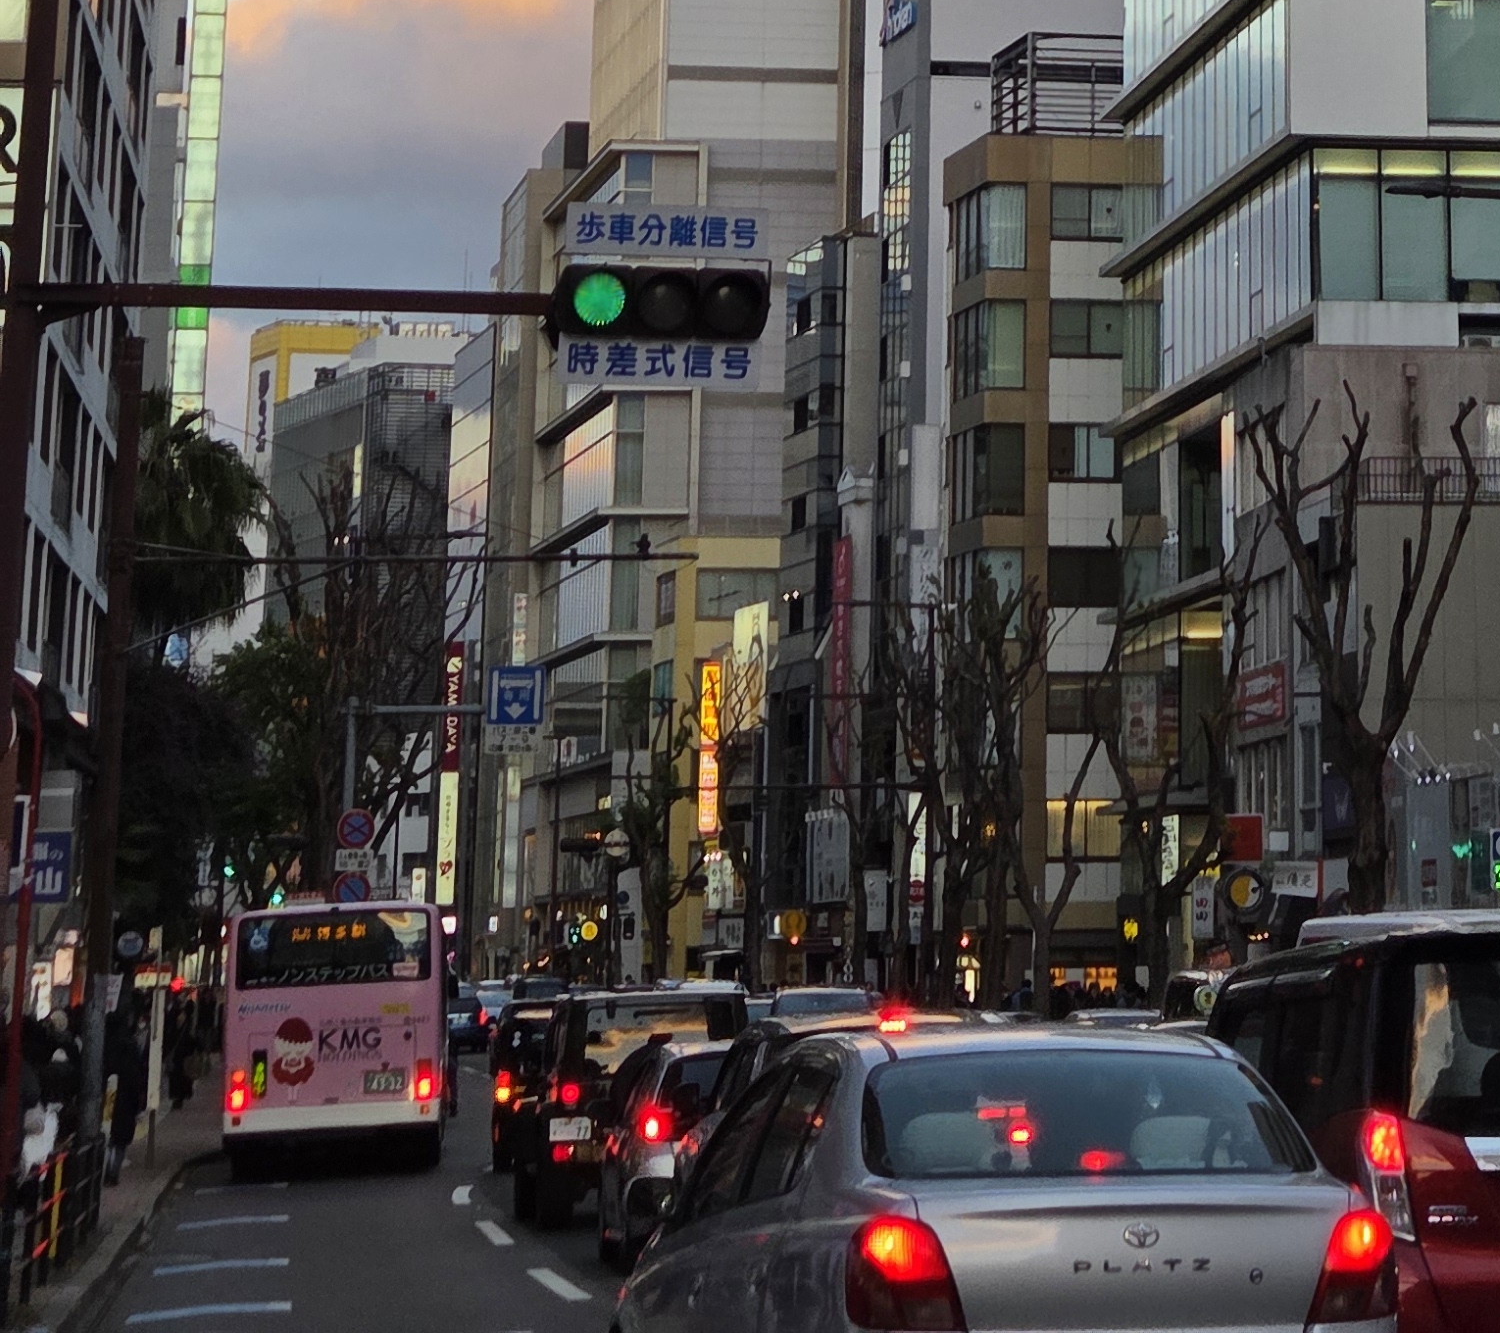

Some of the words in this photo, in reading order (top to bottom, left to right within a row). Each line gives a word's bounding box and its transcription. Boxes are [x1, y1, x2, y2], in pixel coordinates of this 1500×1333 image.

[576, 211, 759, 250] 歩車分離信号
[567, 341, 752, 379] 時差式信号
[445, 674, 459, 753] YAMDAYA
[278, 964, 388, 984] ノンステップバス
[319, 1026, 382, 1052] KMG
[1073, 1257, 1211, 1274] PLATZ
